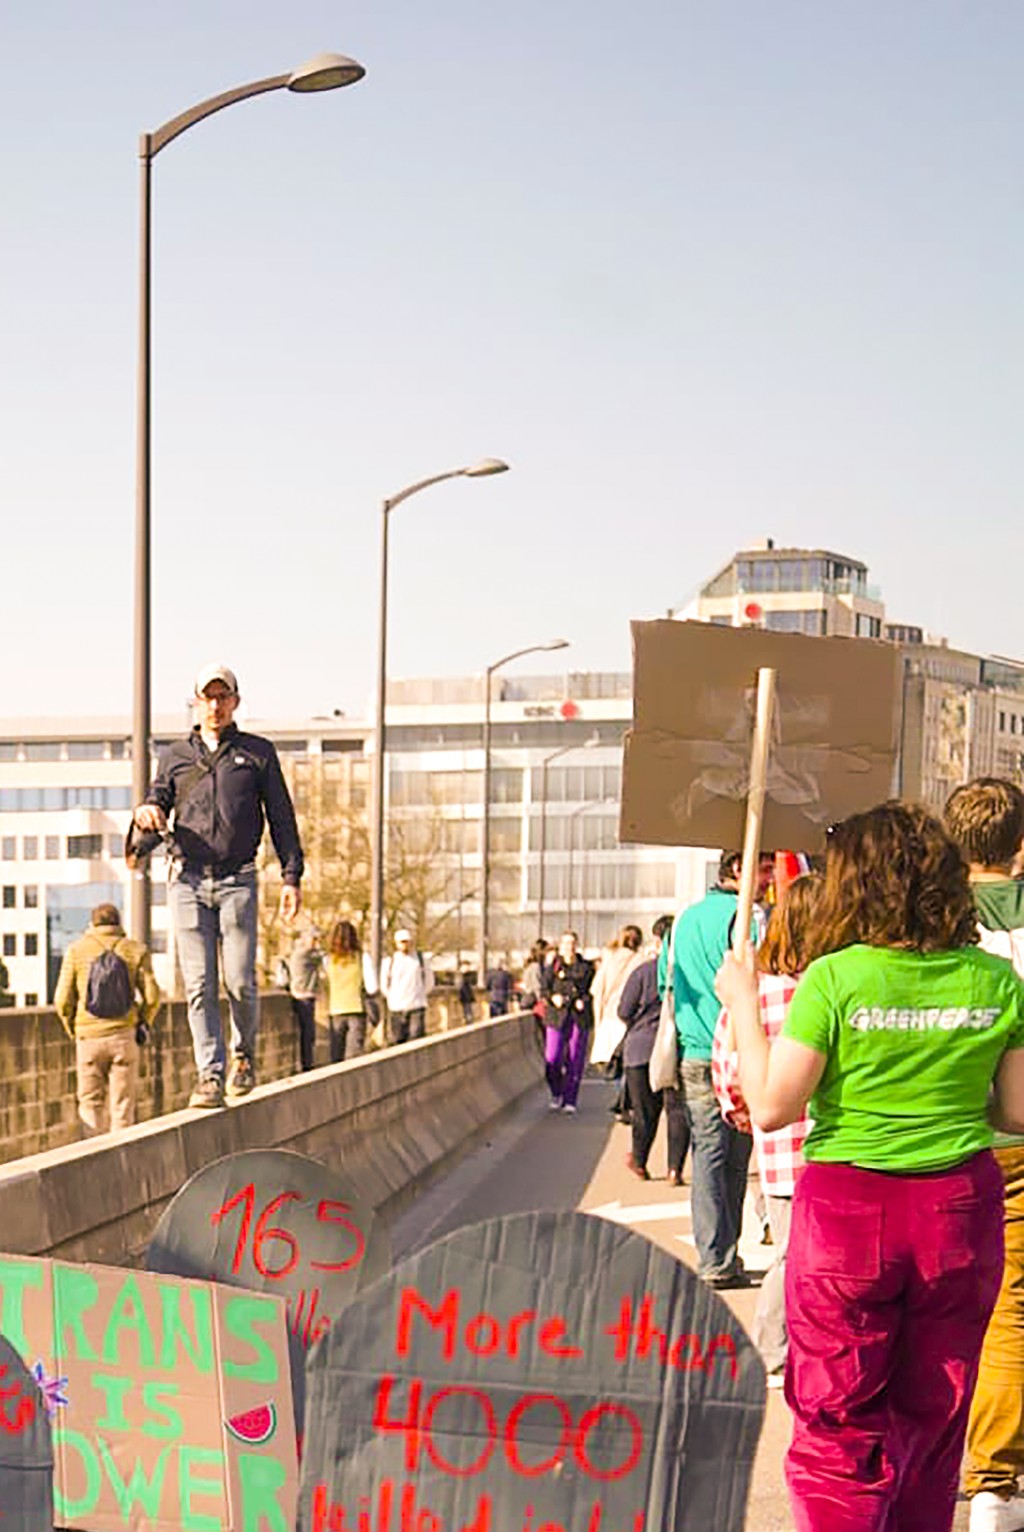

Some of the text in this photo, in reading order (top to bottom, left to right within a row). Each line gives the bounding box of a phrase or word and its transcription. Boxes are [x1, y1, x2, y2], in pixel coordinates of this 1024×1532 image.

[211, 1183, 364, 1280] 165
[396, 1287, 739, 1379] More than
[92, 1375, 185, 1440] IS
[372, 1374, 642, 1486] 4000
